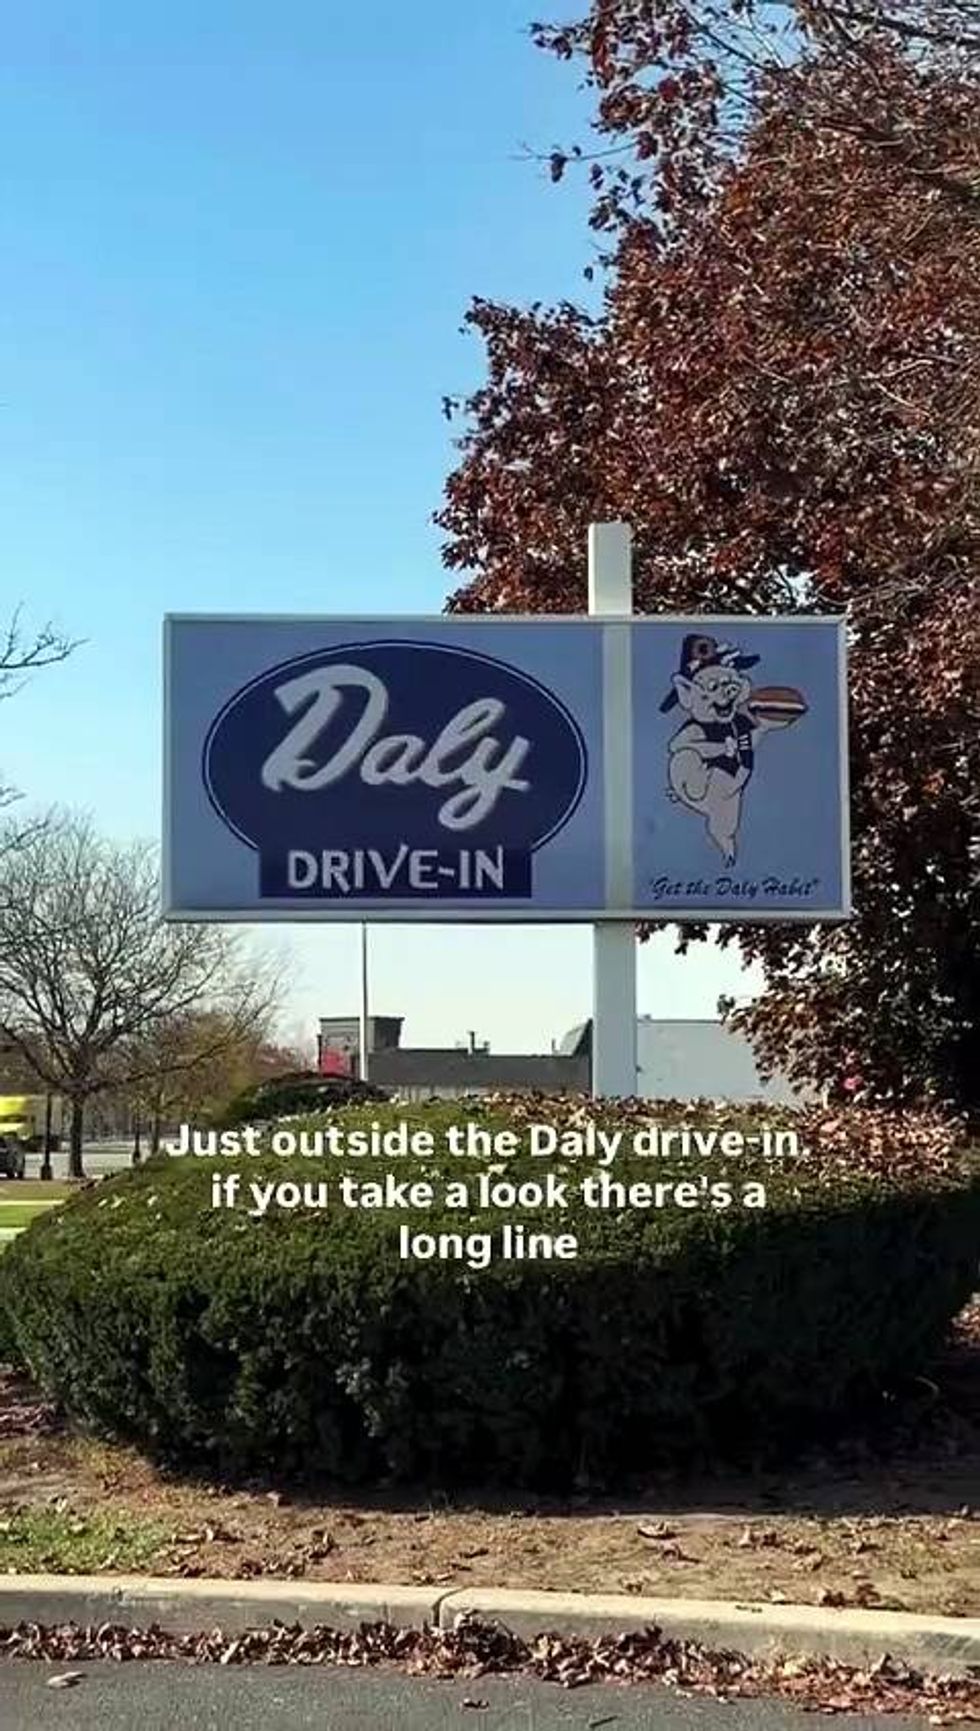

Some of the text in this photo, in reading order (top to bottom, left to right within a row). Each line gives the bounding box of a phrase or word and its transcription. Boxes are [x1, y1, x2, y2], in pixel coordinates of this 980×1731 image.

[261, 664, 531, 831] Daly
[286, 844, 505, 892] DRIVE-IN
[686, 877, 711, 896] the
[714, 876, 757, 897] Daly
